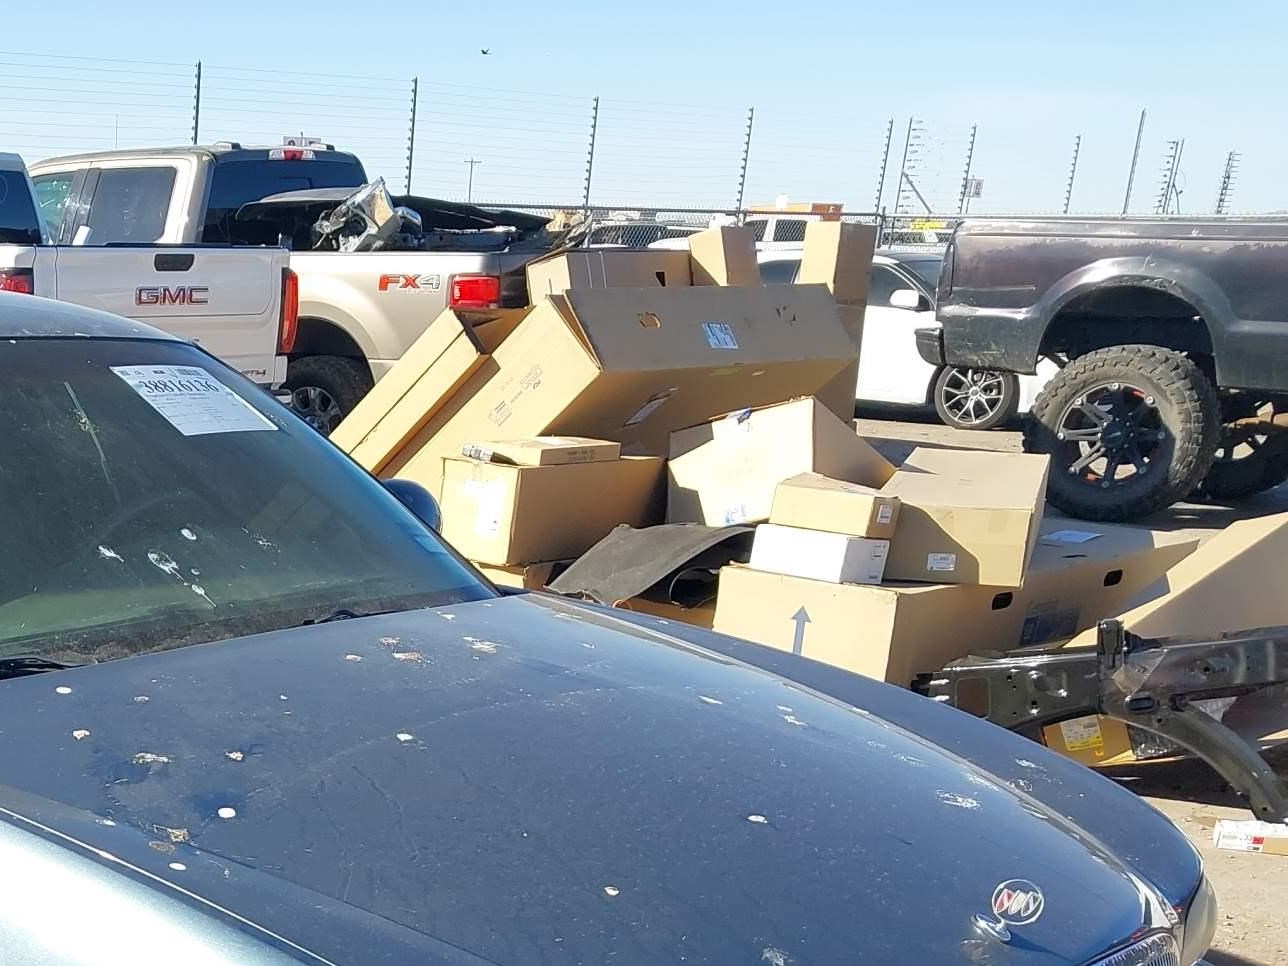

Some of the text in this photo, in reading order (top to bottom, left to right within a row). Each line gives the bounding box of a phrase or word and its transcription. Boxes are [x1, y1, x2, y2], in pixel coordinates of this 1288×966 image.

[378, 273, 441, 292] FX4
[135, 286, 209, 305] GMC
[138, 379, 220, 394] 38816136
